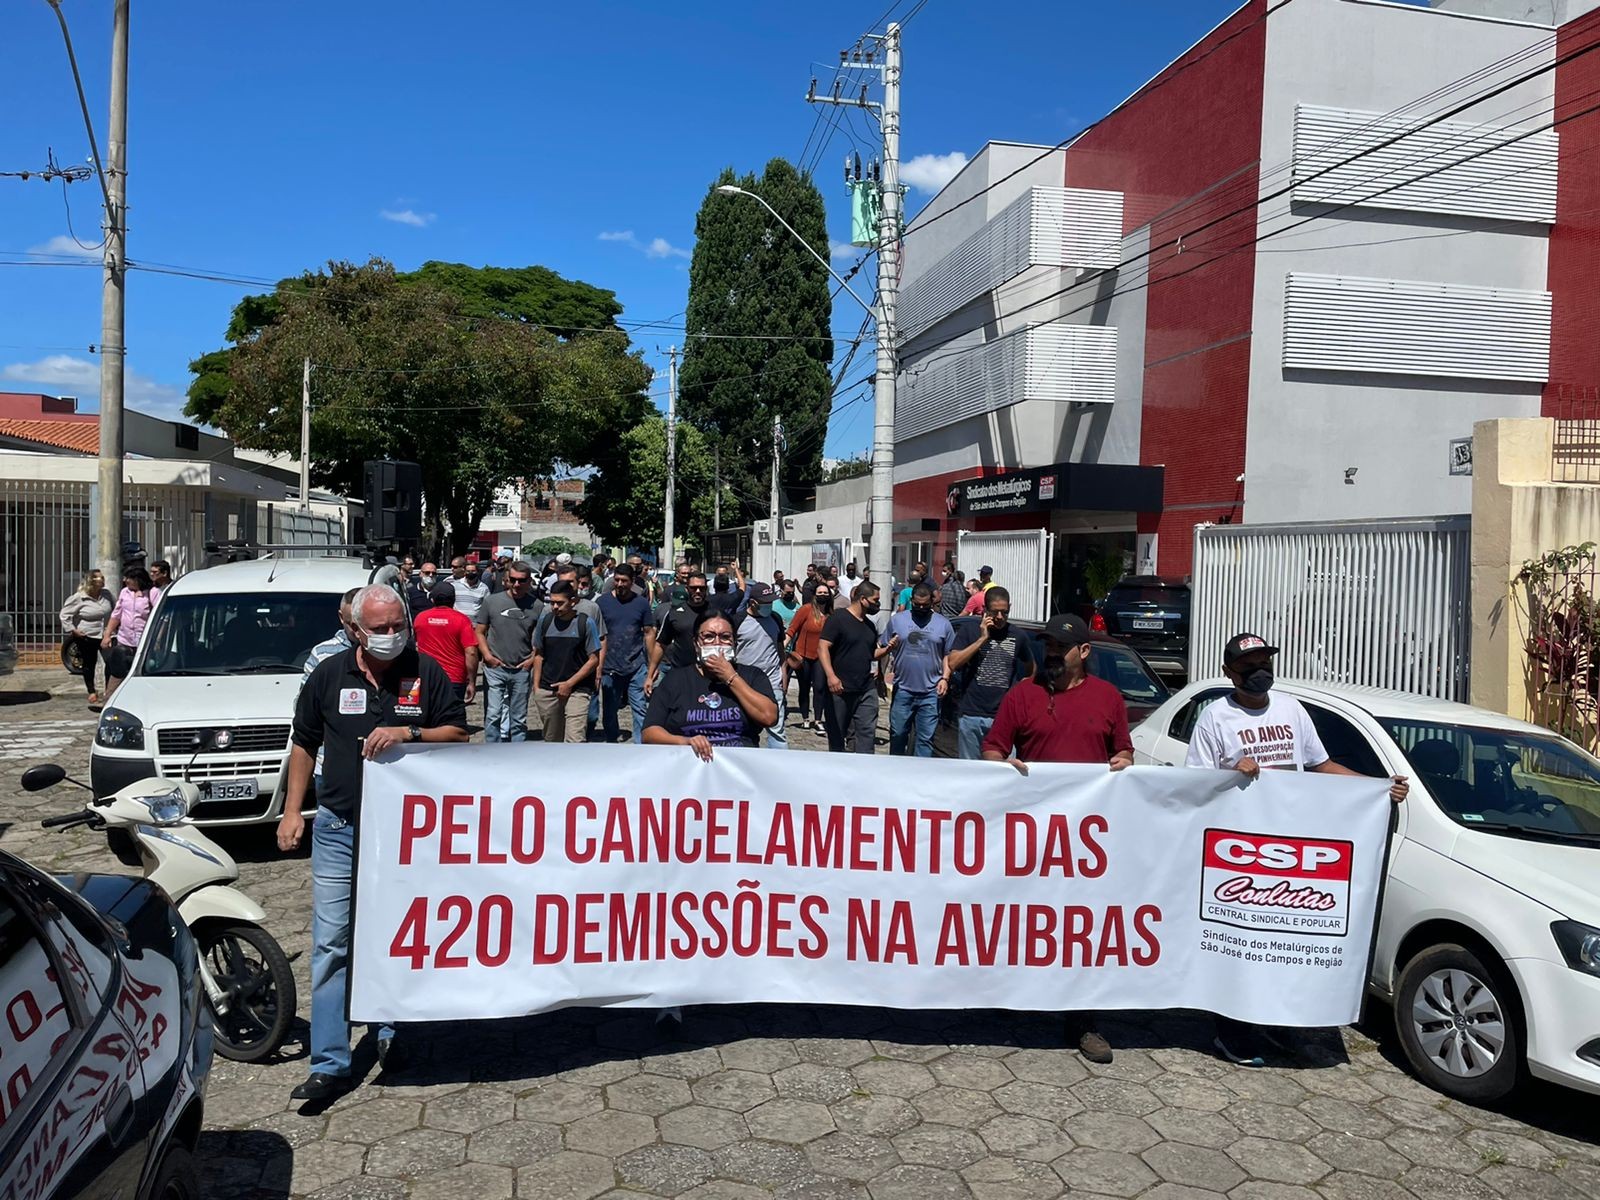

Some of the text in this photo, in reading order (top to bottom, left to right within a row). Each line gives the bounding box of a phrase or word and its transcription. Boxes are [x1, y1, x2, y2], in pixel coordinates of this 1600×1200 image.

[966, 485, 988, 499] Sindicato
[988, 483, 998, 496] dos
[1040, 477, 1054, 485] CSP
[687, 707, 740, 722] MULHERES
[1237, 724, 1294, 745] 10 ANOS
[1243, 741, 1294, 755] DA DESOCUPAÇÃO
[1257, 752, 1294, 763] PINHEIRINHO
[398, 794, 1109, 878] PELO CANCELAMENTO DAS
[1214, 838, 1341, 871] CSP
[1214, 876, 1336, 911] Conlutas
[388, 878, 1163, 970] 420 DEMISSÕES NA AVIBRAS
[1208, 905, 1341, 929] CENTRAL SINDICAL E POPULAR
[1202, 929, 1343, 955] Sindicato dos Metalúrgicos de
[1200, 941, 1343, 969] São José dos Campos e Região
